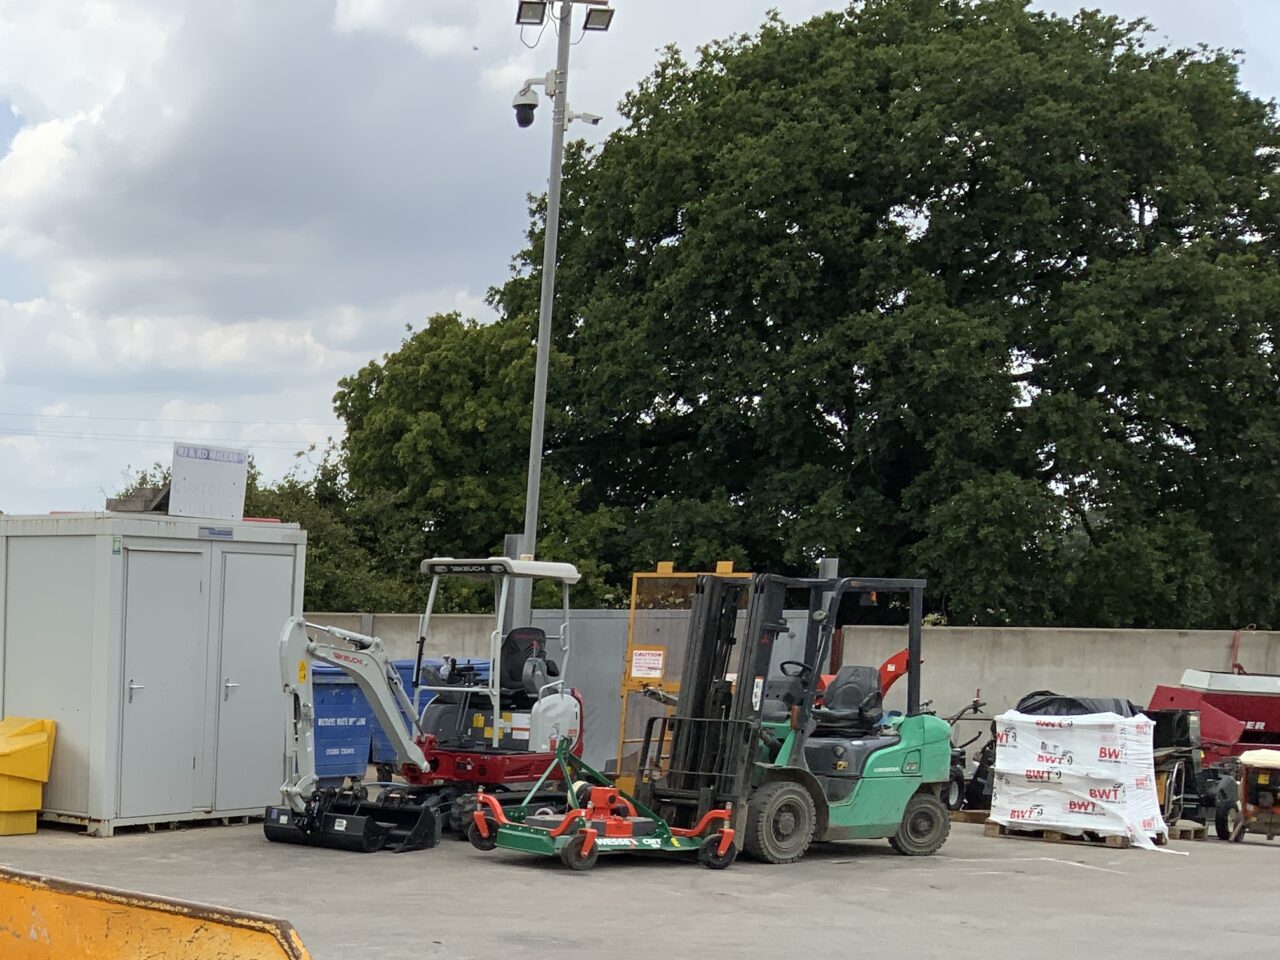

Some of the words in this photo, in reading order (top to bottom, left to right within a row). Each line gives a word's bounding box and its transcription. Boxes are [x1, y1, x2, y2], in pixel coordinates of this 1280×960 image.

[1036, 754, 1064, 765] BWT
[1025, 769, 1053, 781] BWT
[1089, 788, 1120, 801] BWT
[1068, 800, 1097, 812] BWT
[1009, 808, 1034, 820] BWT
[594, 838, 639, 846] WESSEX
